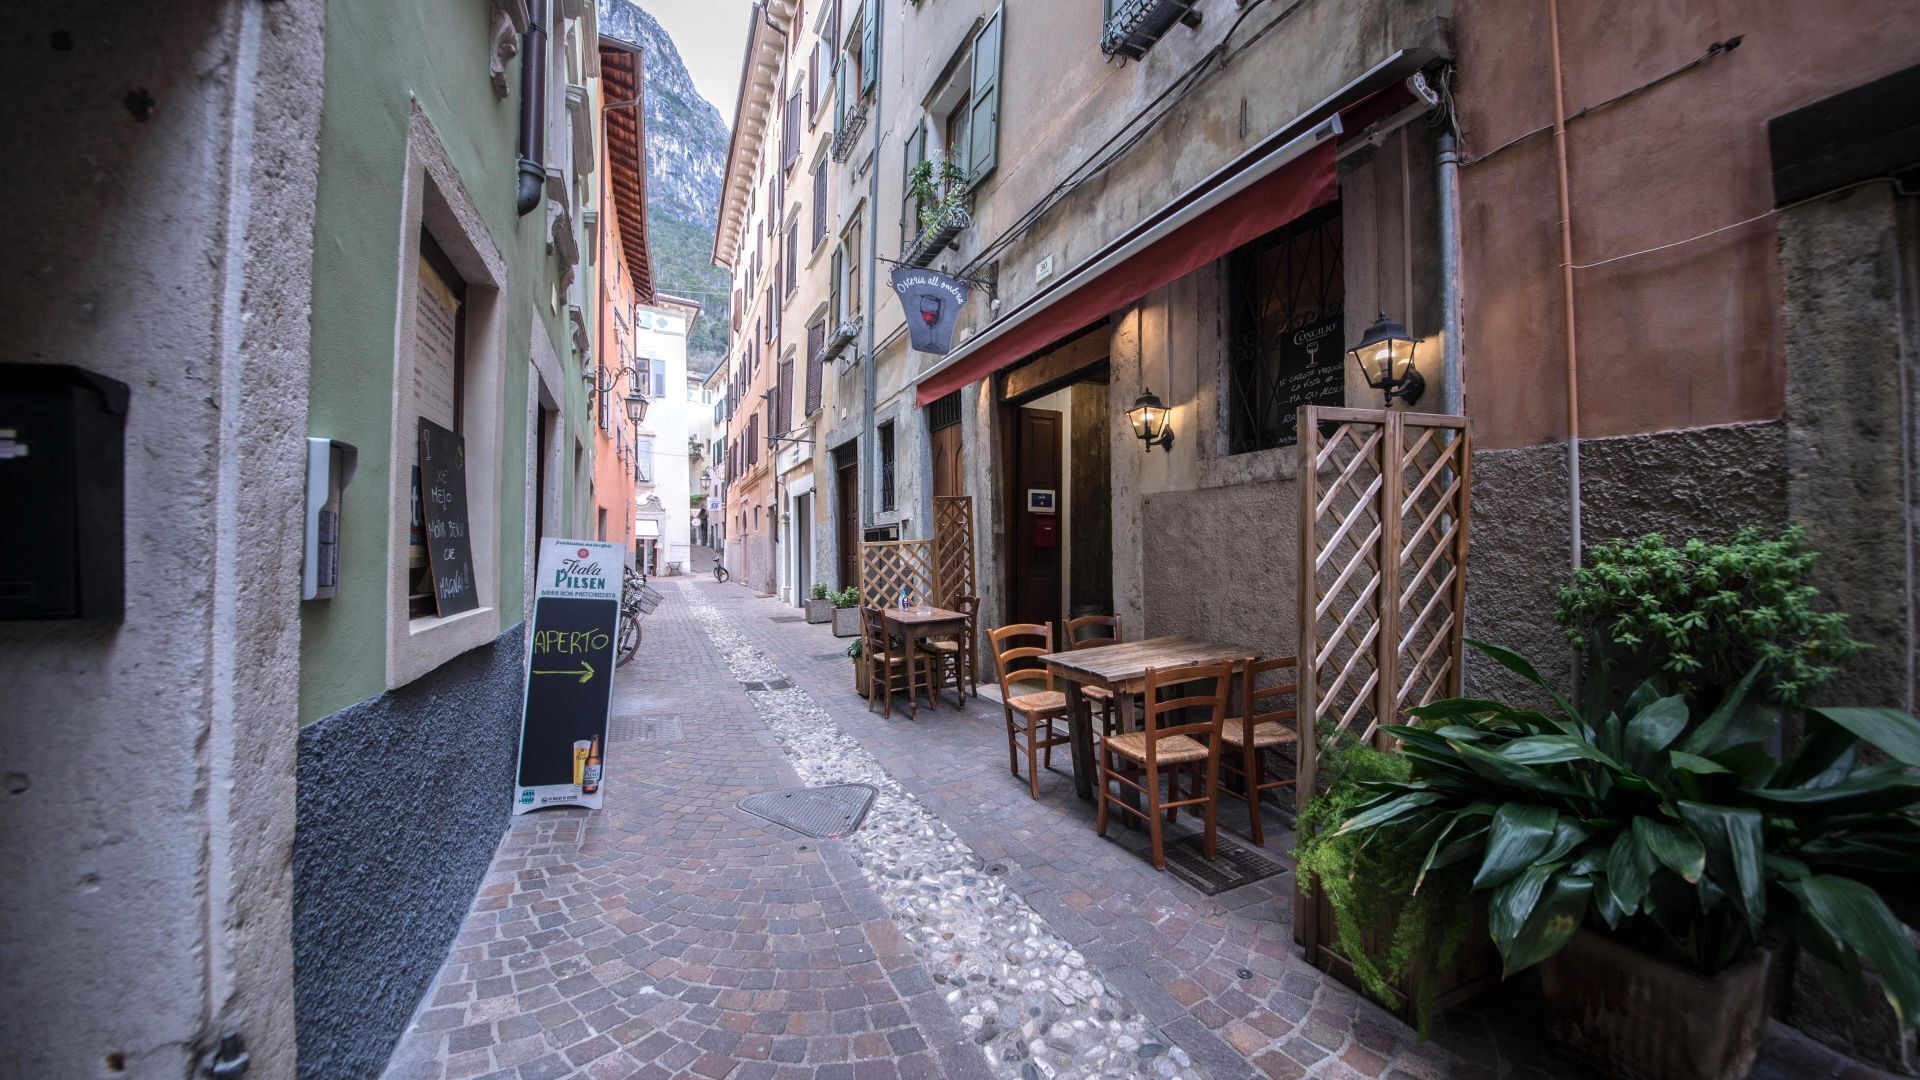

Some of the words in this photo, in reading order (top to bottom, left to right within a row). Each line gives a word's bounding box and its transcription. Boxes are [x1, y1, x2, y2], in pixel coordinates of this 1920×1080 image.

[896, 276, 926, 293] Osteria
[940, 281, 964, 305] ombra
[560, 558, 602, 576] Itala
[554, 569, 606, 590] PILSEN
[534, 628, 609, 655] APERTO
